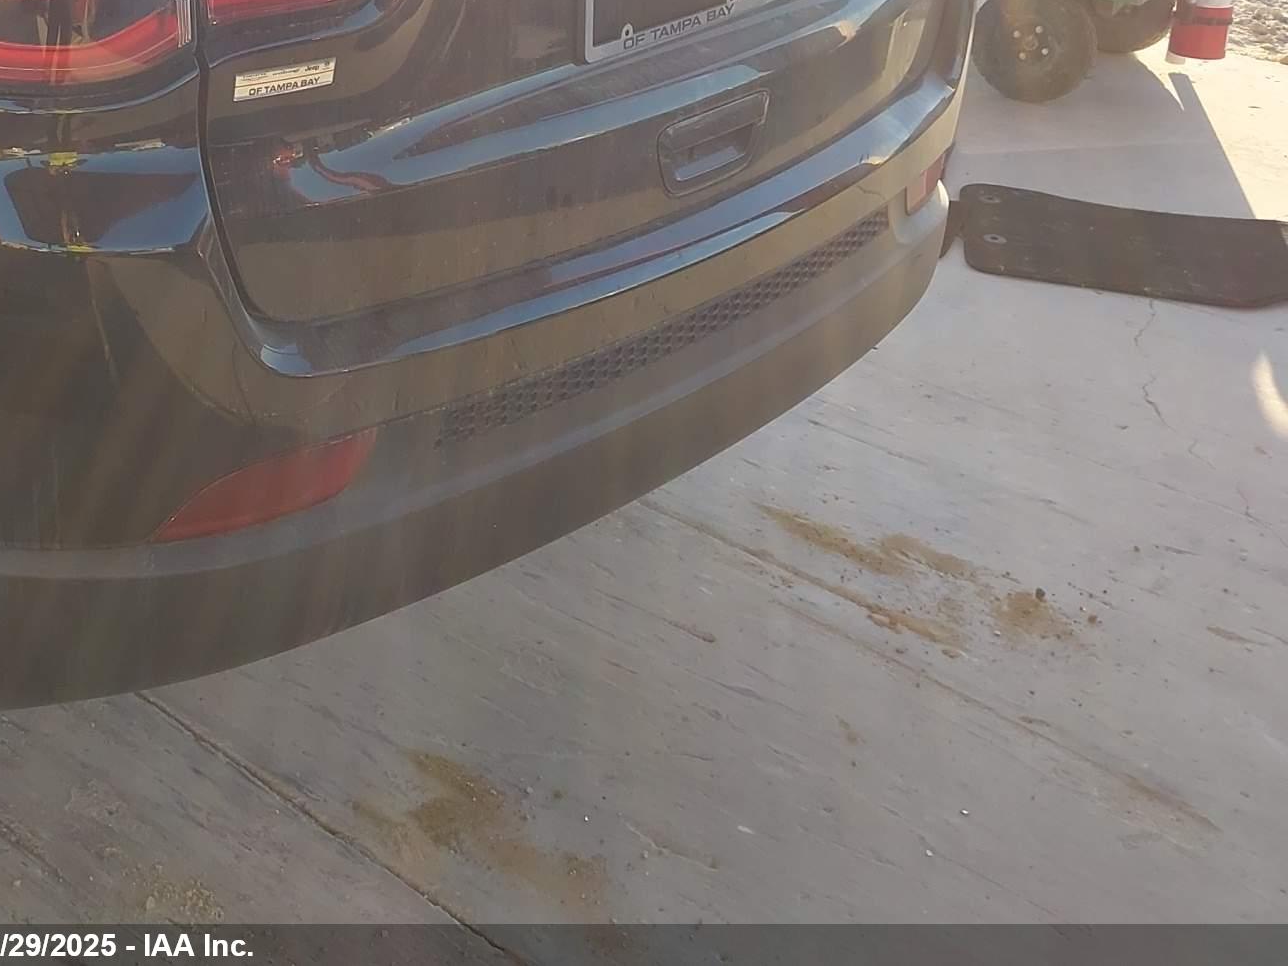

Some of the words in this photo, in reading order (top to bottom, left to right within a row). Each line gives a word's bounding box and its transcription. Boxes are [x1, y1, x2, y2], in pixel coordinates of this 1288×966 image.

[623, 34, 646, 50] OF
[650, 15, 702, 42] TAMPA
[706, 3, 735, 23] BAY
[249, 87, 262, 96] OF
[264, 82, 299, 94] TAMPA
[300, 76, 321, 87] BAY
